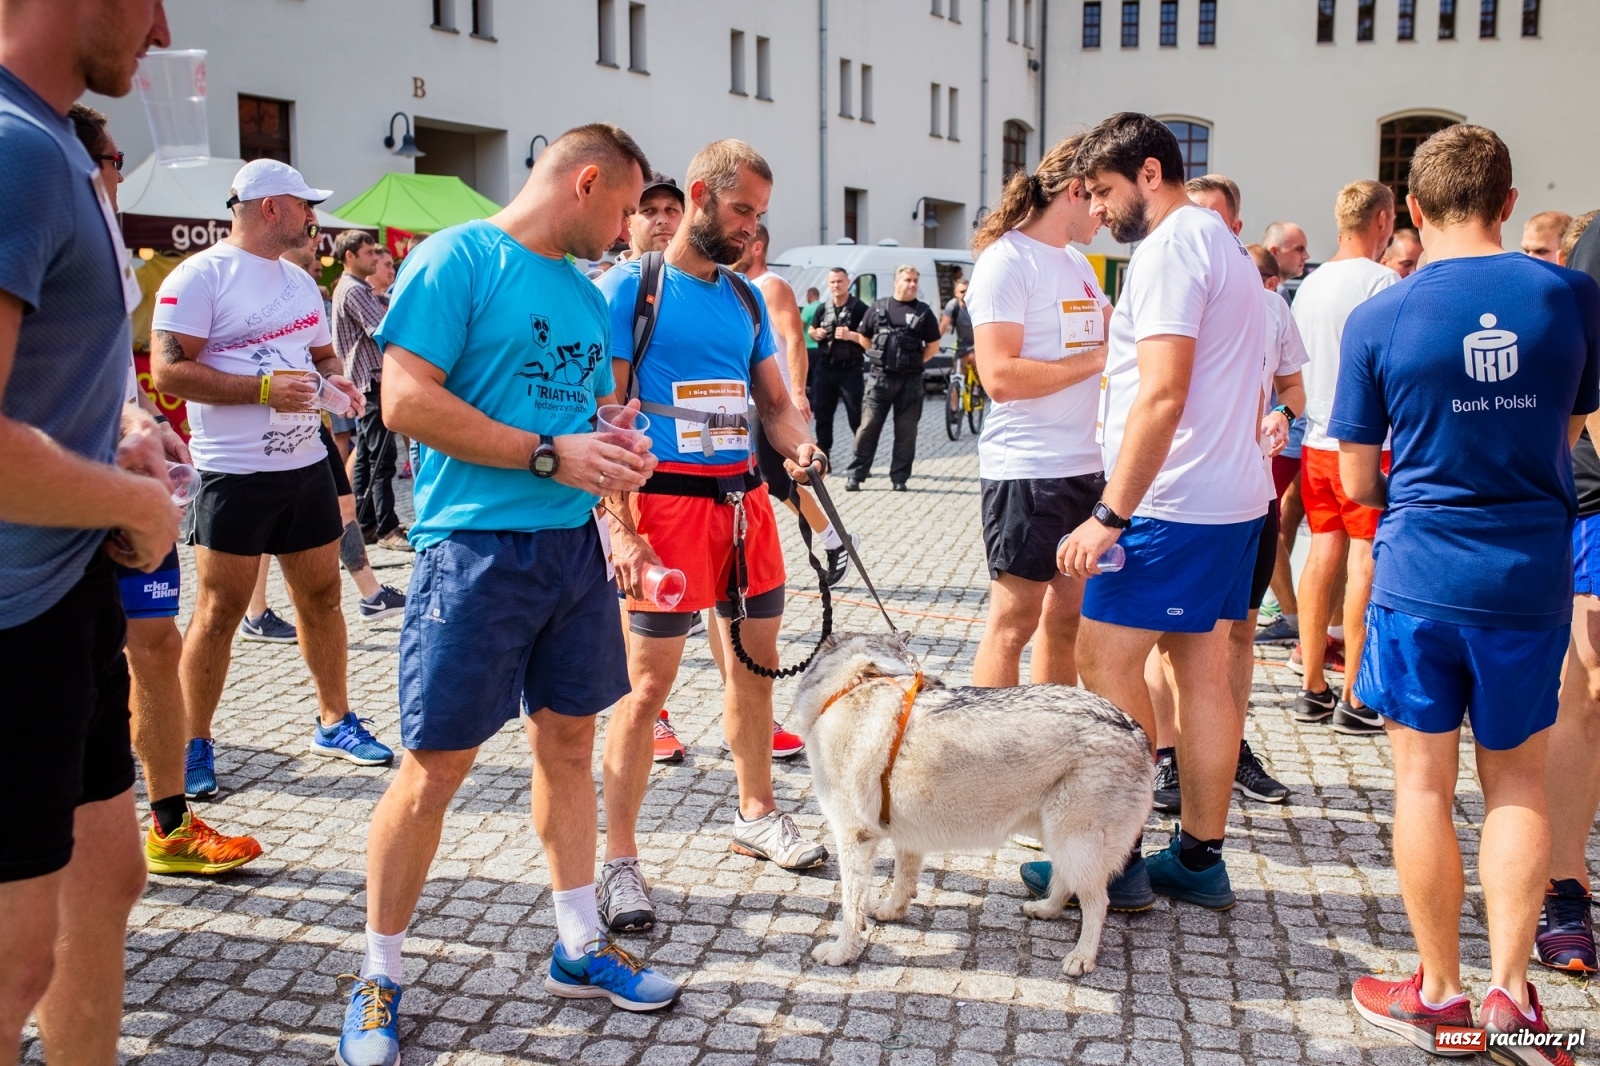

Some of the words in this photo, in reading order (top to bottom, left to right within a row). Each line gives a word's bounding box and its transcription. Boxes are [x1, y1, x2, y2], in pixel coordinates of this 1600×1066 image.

[412, 76, 426, 99] B
[244, 312, 262, 328] KS
[261, 298, 282, 318] GRYF
[1084, 320, 1094, 335] 47
[527, 383, 533, 397] I
[1452, 397, 1490, 413] Bank
[1494, 394, 1537, 410] Polski
